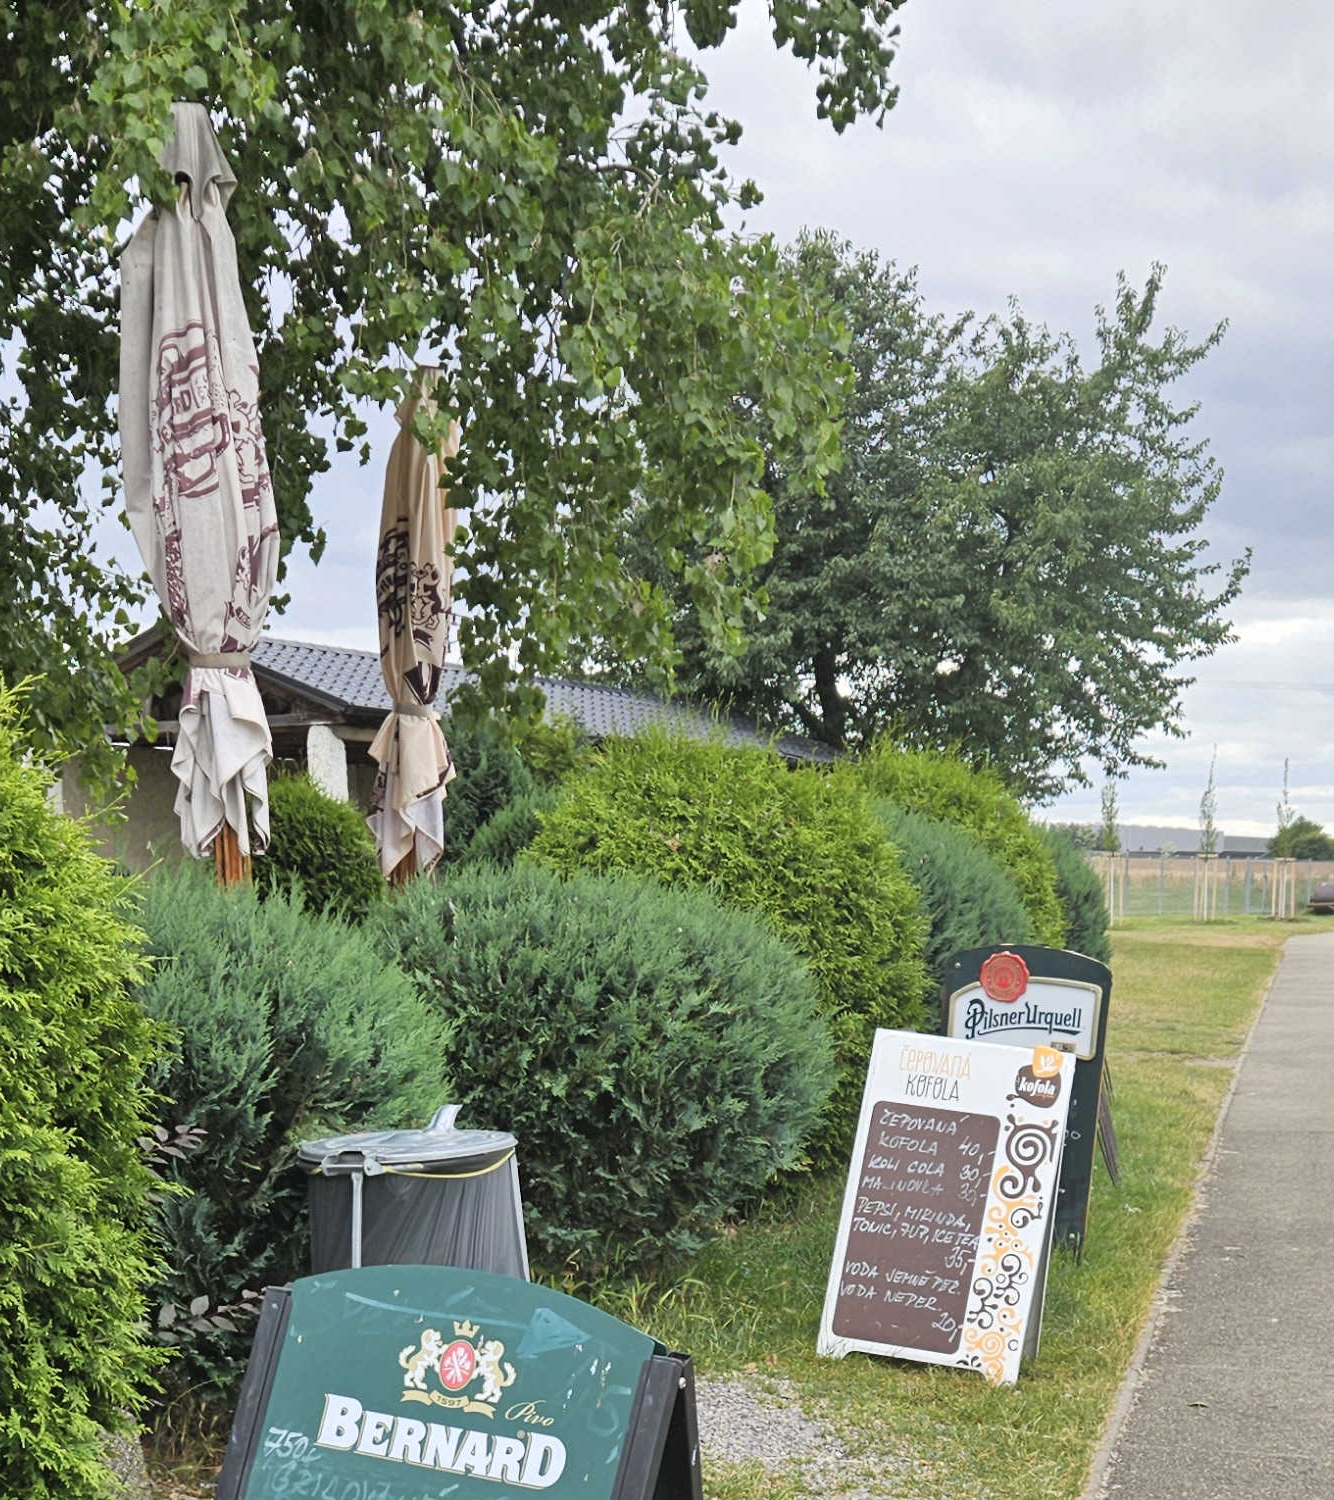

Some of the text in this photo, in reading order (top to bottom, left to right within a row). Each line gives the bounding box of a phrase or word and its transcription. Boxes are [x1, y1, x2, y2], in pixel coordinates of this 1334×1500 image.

[964, 998, 1082, 1039] Pilsner Urquell
[905, 1074, 960, 1102] KOFOLA
[1018, 1076, 1055, 1096] kofola
[878, 1131, 938, 1155] KOFOLA
[907, 1160, 945, 1177] COLA
[857, 1196, 971, 1231] PEPSI, MIRINDA,
[853, 1217, 897, 1240] TONIC,
[931, 1228, 956, 1244] ICE
[954, 1232, 980, 1250] TEA
[845, 1260, 879, 1278] VODA
[840, 1280, 877, 1299] VODA
[436, 1395, 462, 1407] 1597
[504, 1400, 555, 1427] Pivo
[314, 1393, 567, 1490] BERNARD
